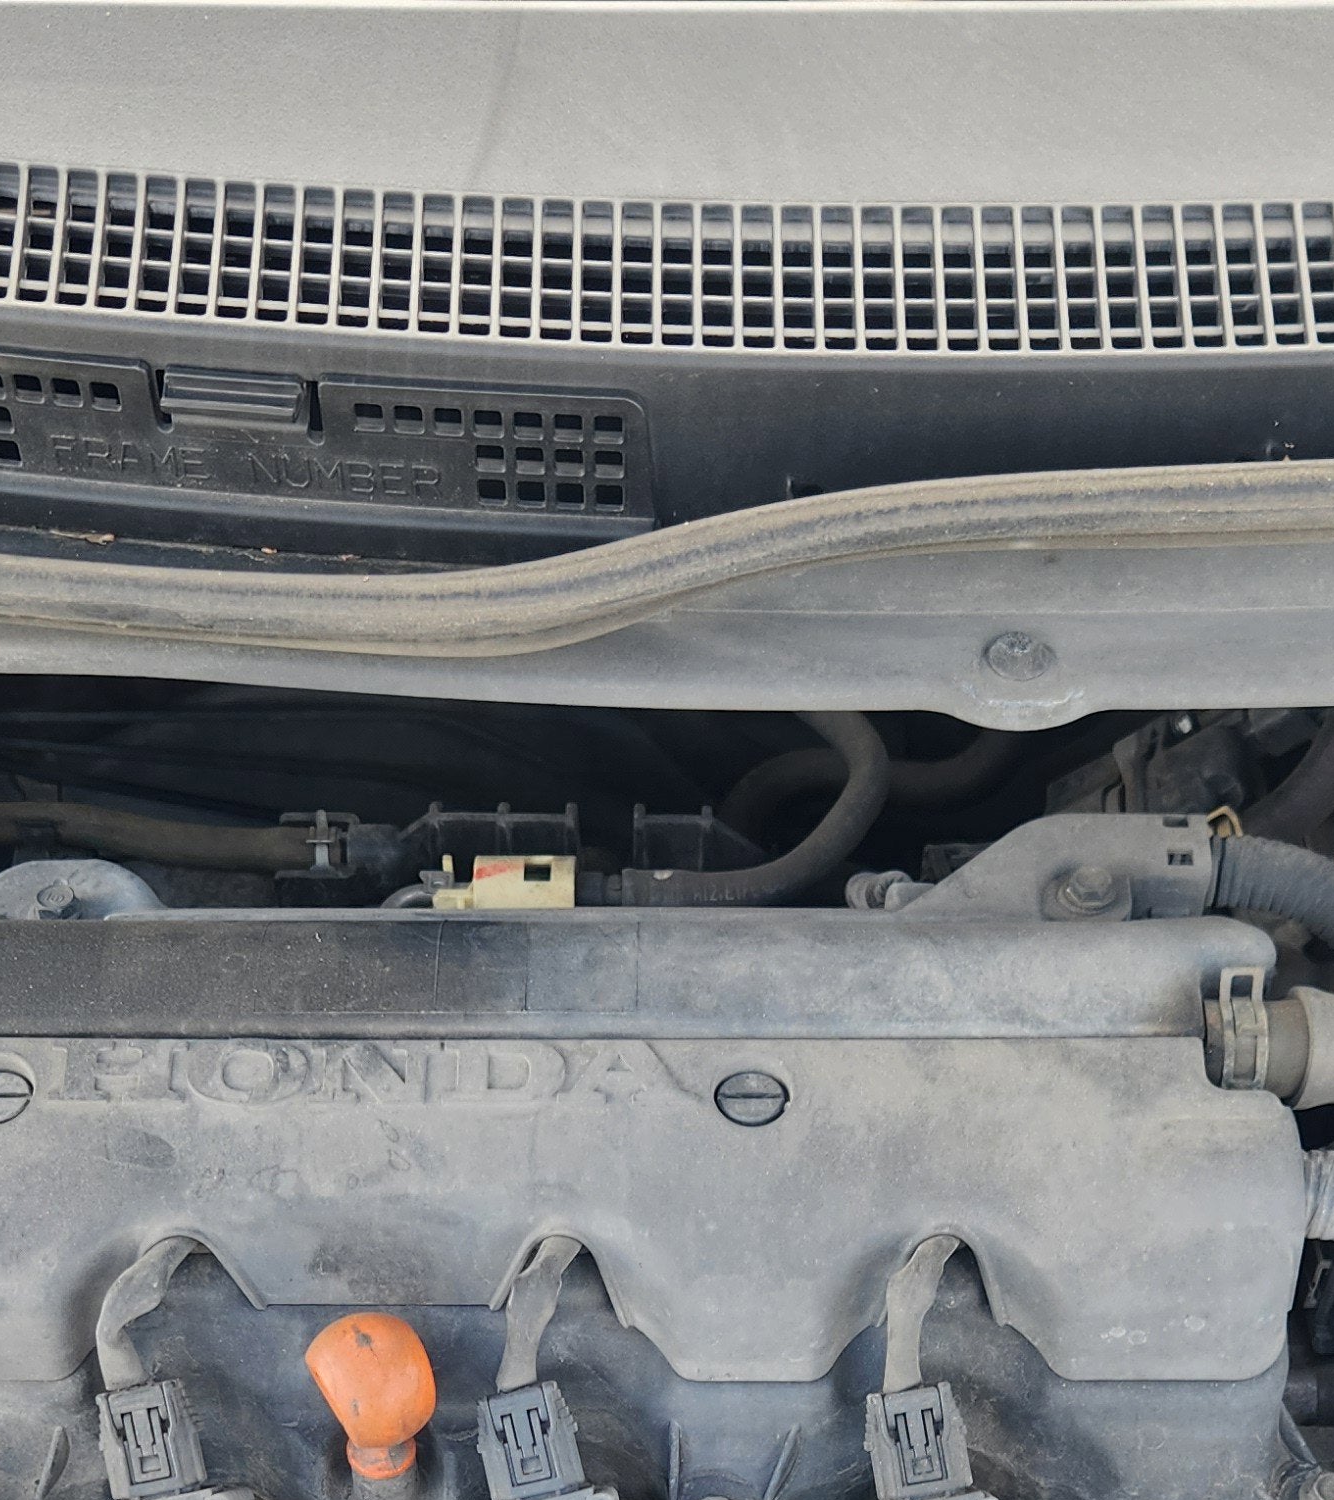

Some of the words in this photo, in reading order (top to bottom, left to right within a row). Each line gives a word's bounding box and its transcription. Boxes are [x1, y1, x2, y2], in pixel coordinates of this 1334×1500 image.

[49, 433, 211, 483] FRAME
[247, 451, 441, 498] NUMBER
[48, 1037, 701, 1105] HONDA
